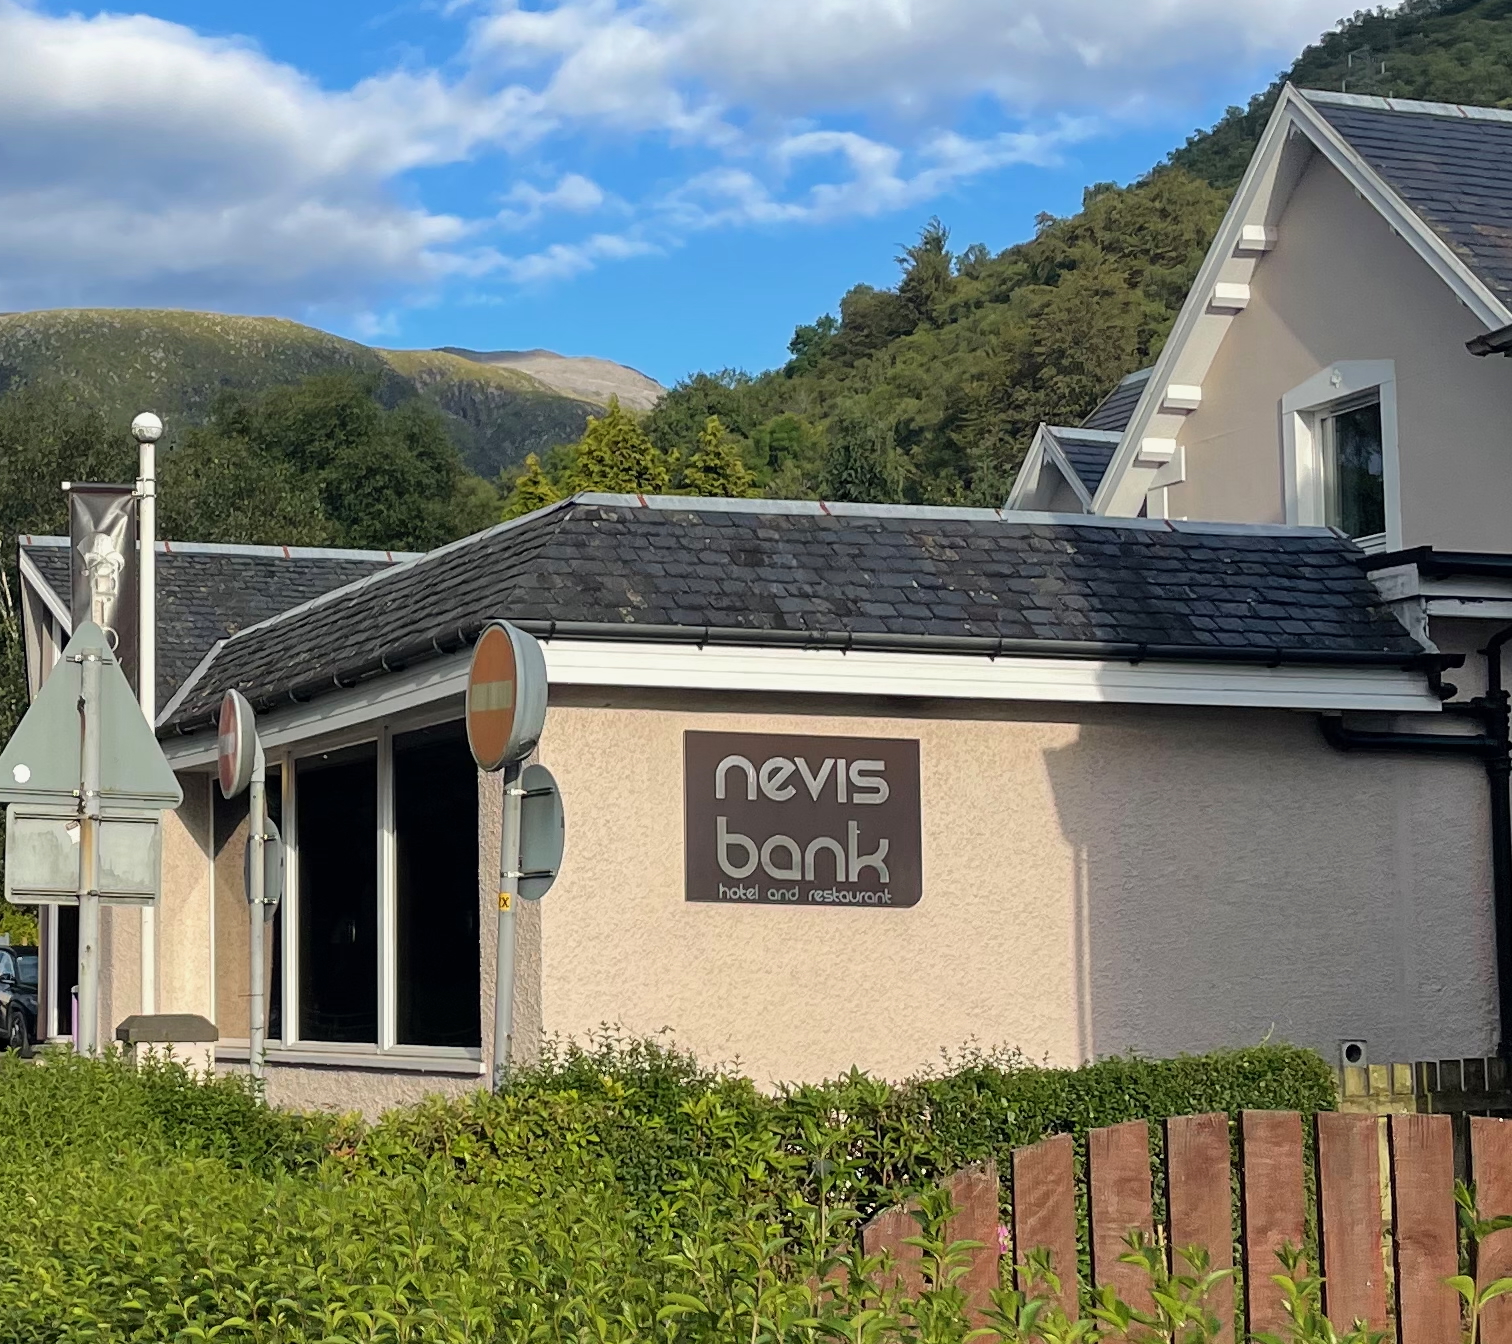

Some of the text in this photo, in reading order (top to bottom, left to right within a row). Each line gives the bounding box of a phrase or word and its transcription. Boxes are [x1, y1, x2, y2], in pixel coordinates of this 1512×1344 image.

[715, 754, 890, 805] nevis
[716, 816, 890, 883] bank
[719, 882, 892, 904] hotel and restaurant
